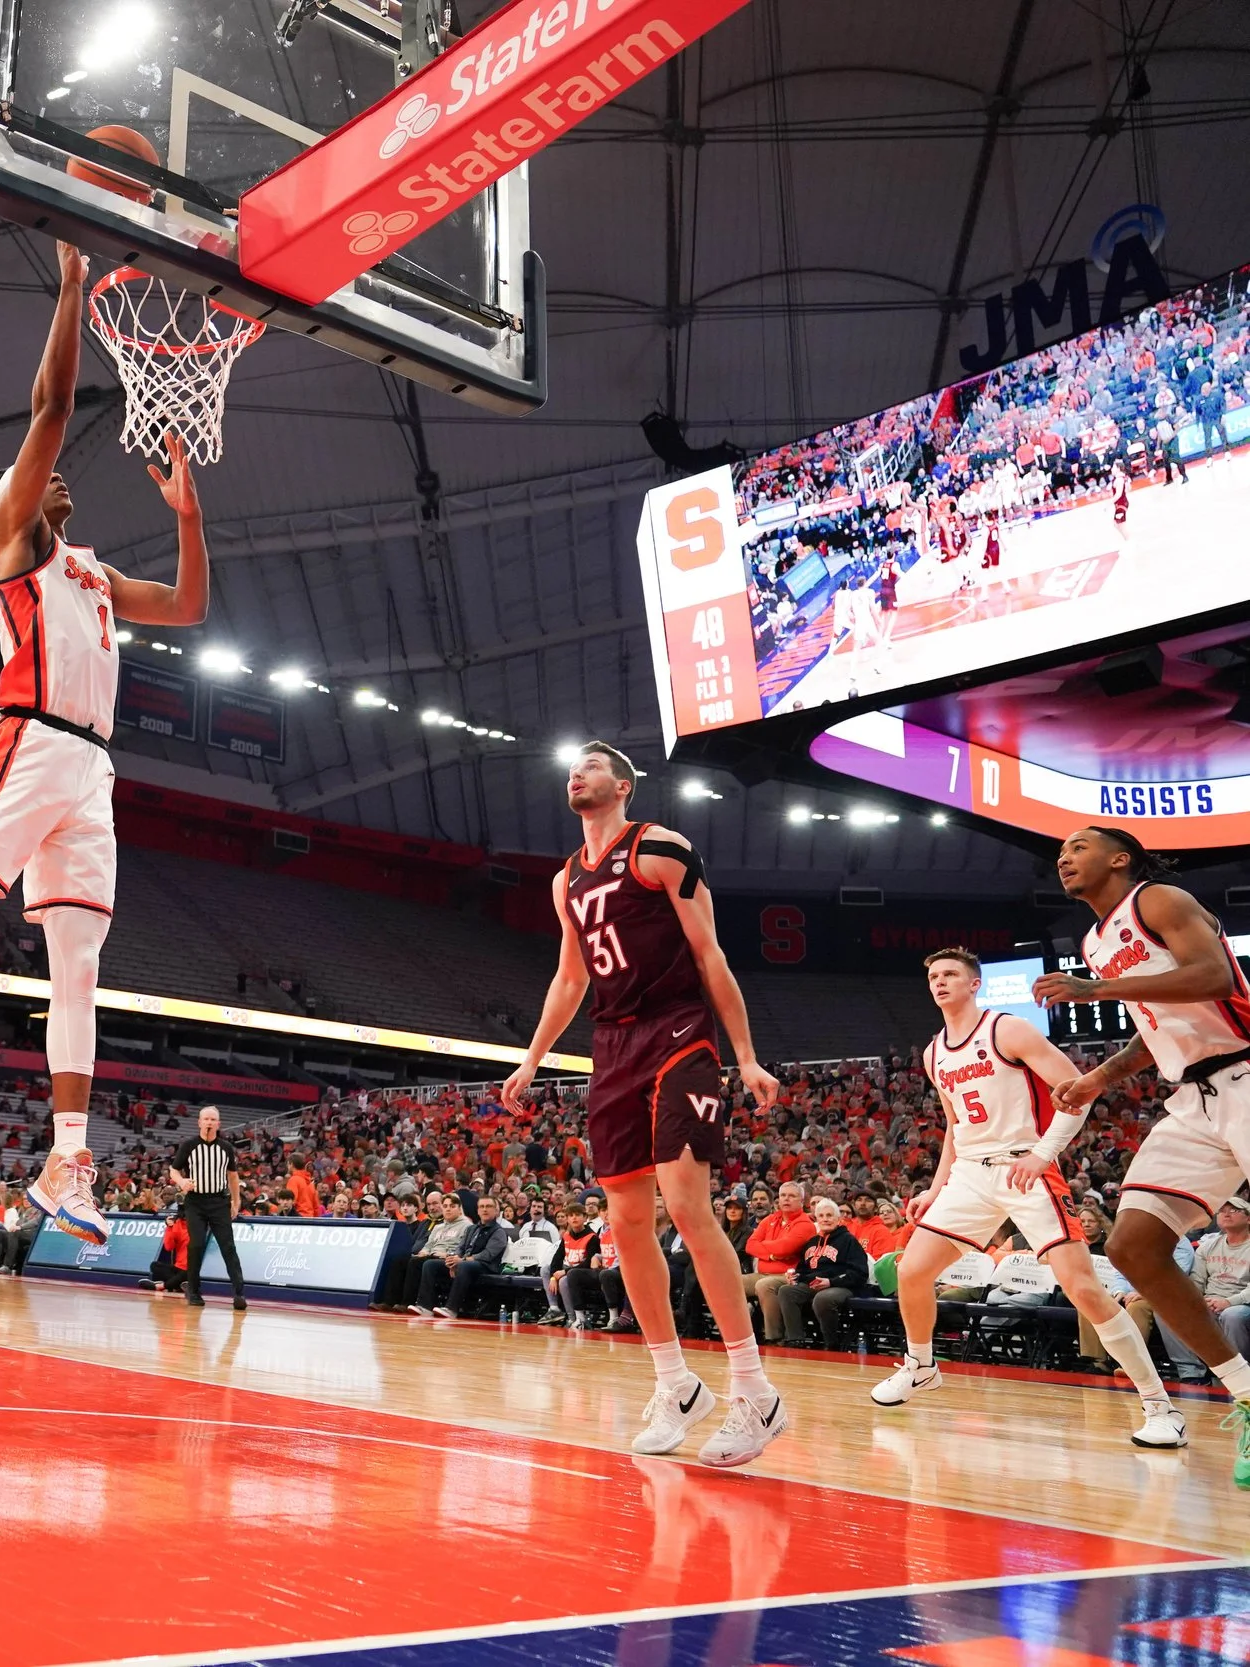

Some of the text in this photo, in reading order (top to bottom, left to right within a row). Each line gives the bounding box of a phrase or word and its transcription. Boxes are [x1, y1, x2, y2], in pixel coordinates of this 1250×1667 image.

[960, 233, 1170, 373] JMA
[665, 487, 726, 572] S
[97, 605, 111, 652] 1
[692, 606, 726, 650] 48
[230, 738, 262, 757] 2009
[948, 746, 1213, 816] 7 10 ASSISTS
[570, 877, 625, 930] VT
[586, 922, 629, 977] 31
[760, 904, 806, 964] S
[870, 925, 1012, 953] SYRACUSE
[222, 1080, 290, 1096] WASHINGTON
[939, 1060, 995, 1093] Syracuse
[962, 1090, 988, 1124] 5
[116, 1220, 166, 1238] LODGE
[233, 1224, 389, 1248] ILWATER LODGE
